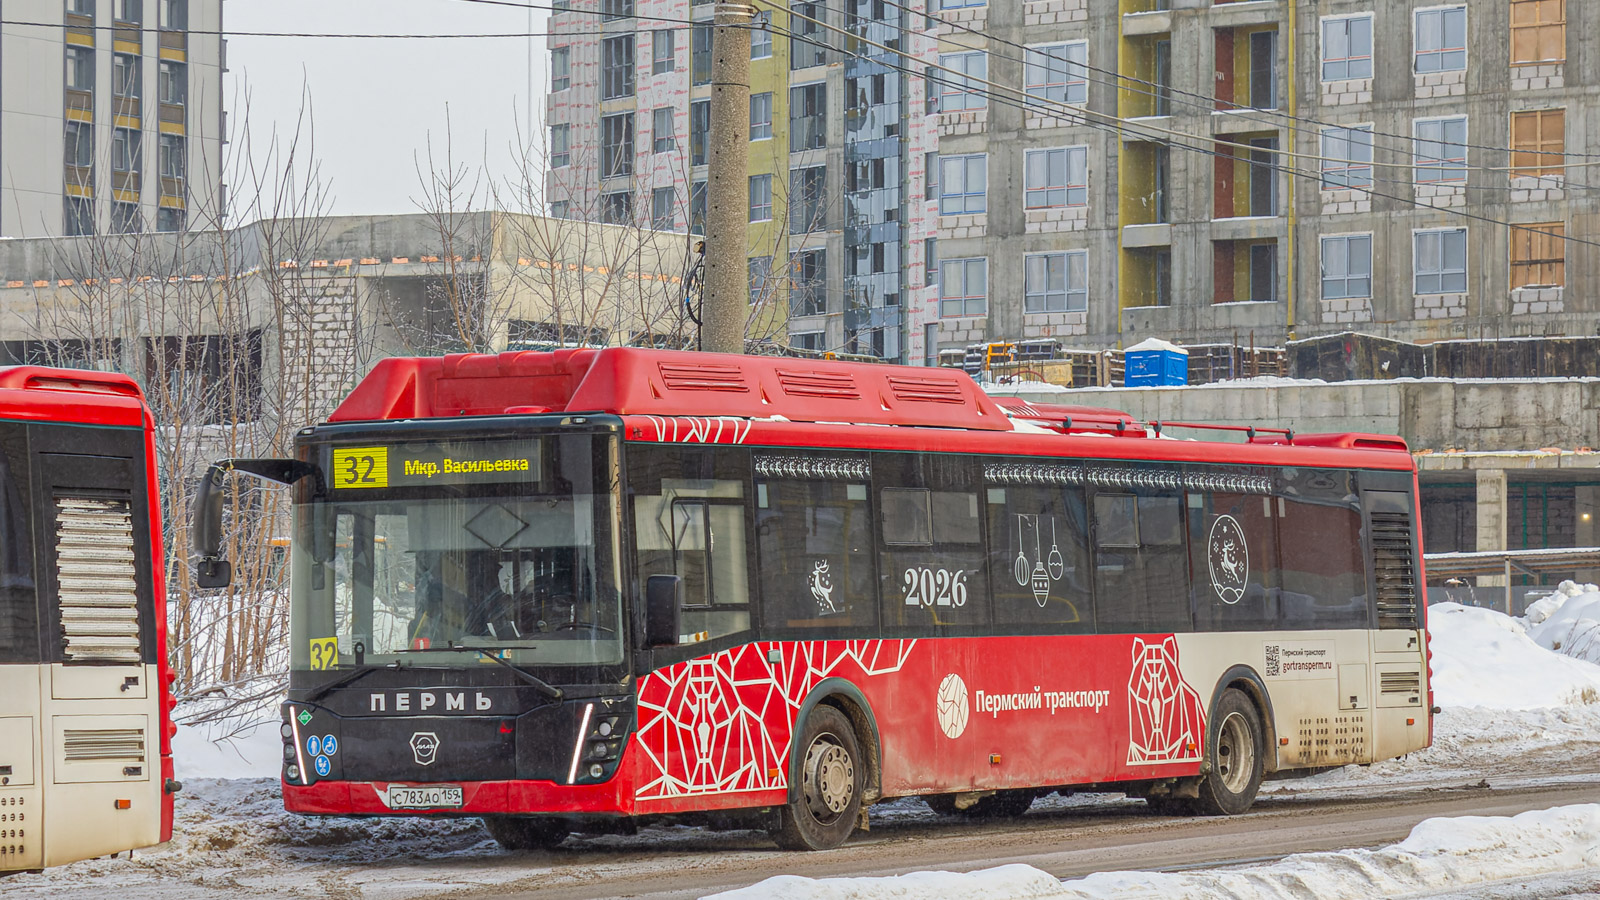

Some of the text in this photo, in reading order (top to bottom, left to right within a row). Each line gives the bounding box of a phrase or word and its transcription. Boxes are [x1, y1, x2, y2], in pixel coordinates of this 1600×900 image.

[344, 456, 376, 484] 32
[404, 458, 529, 478] Мкр. Васильевка
[904, 568, 967, 607] 2026
[311, 641, 336, 671] 32
[1282, 648, 1326, 658] Пермский транспорт
[1283, 661, 1332, 673] gortransperm.ru
[370, 692, 492, 711] ПЕРМЬ
[975, 685, 1110, 719] Пермский транспорт
[394, 789, 459, 805] С783АО 159
